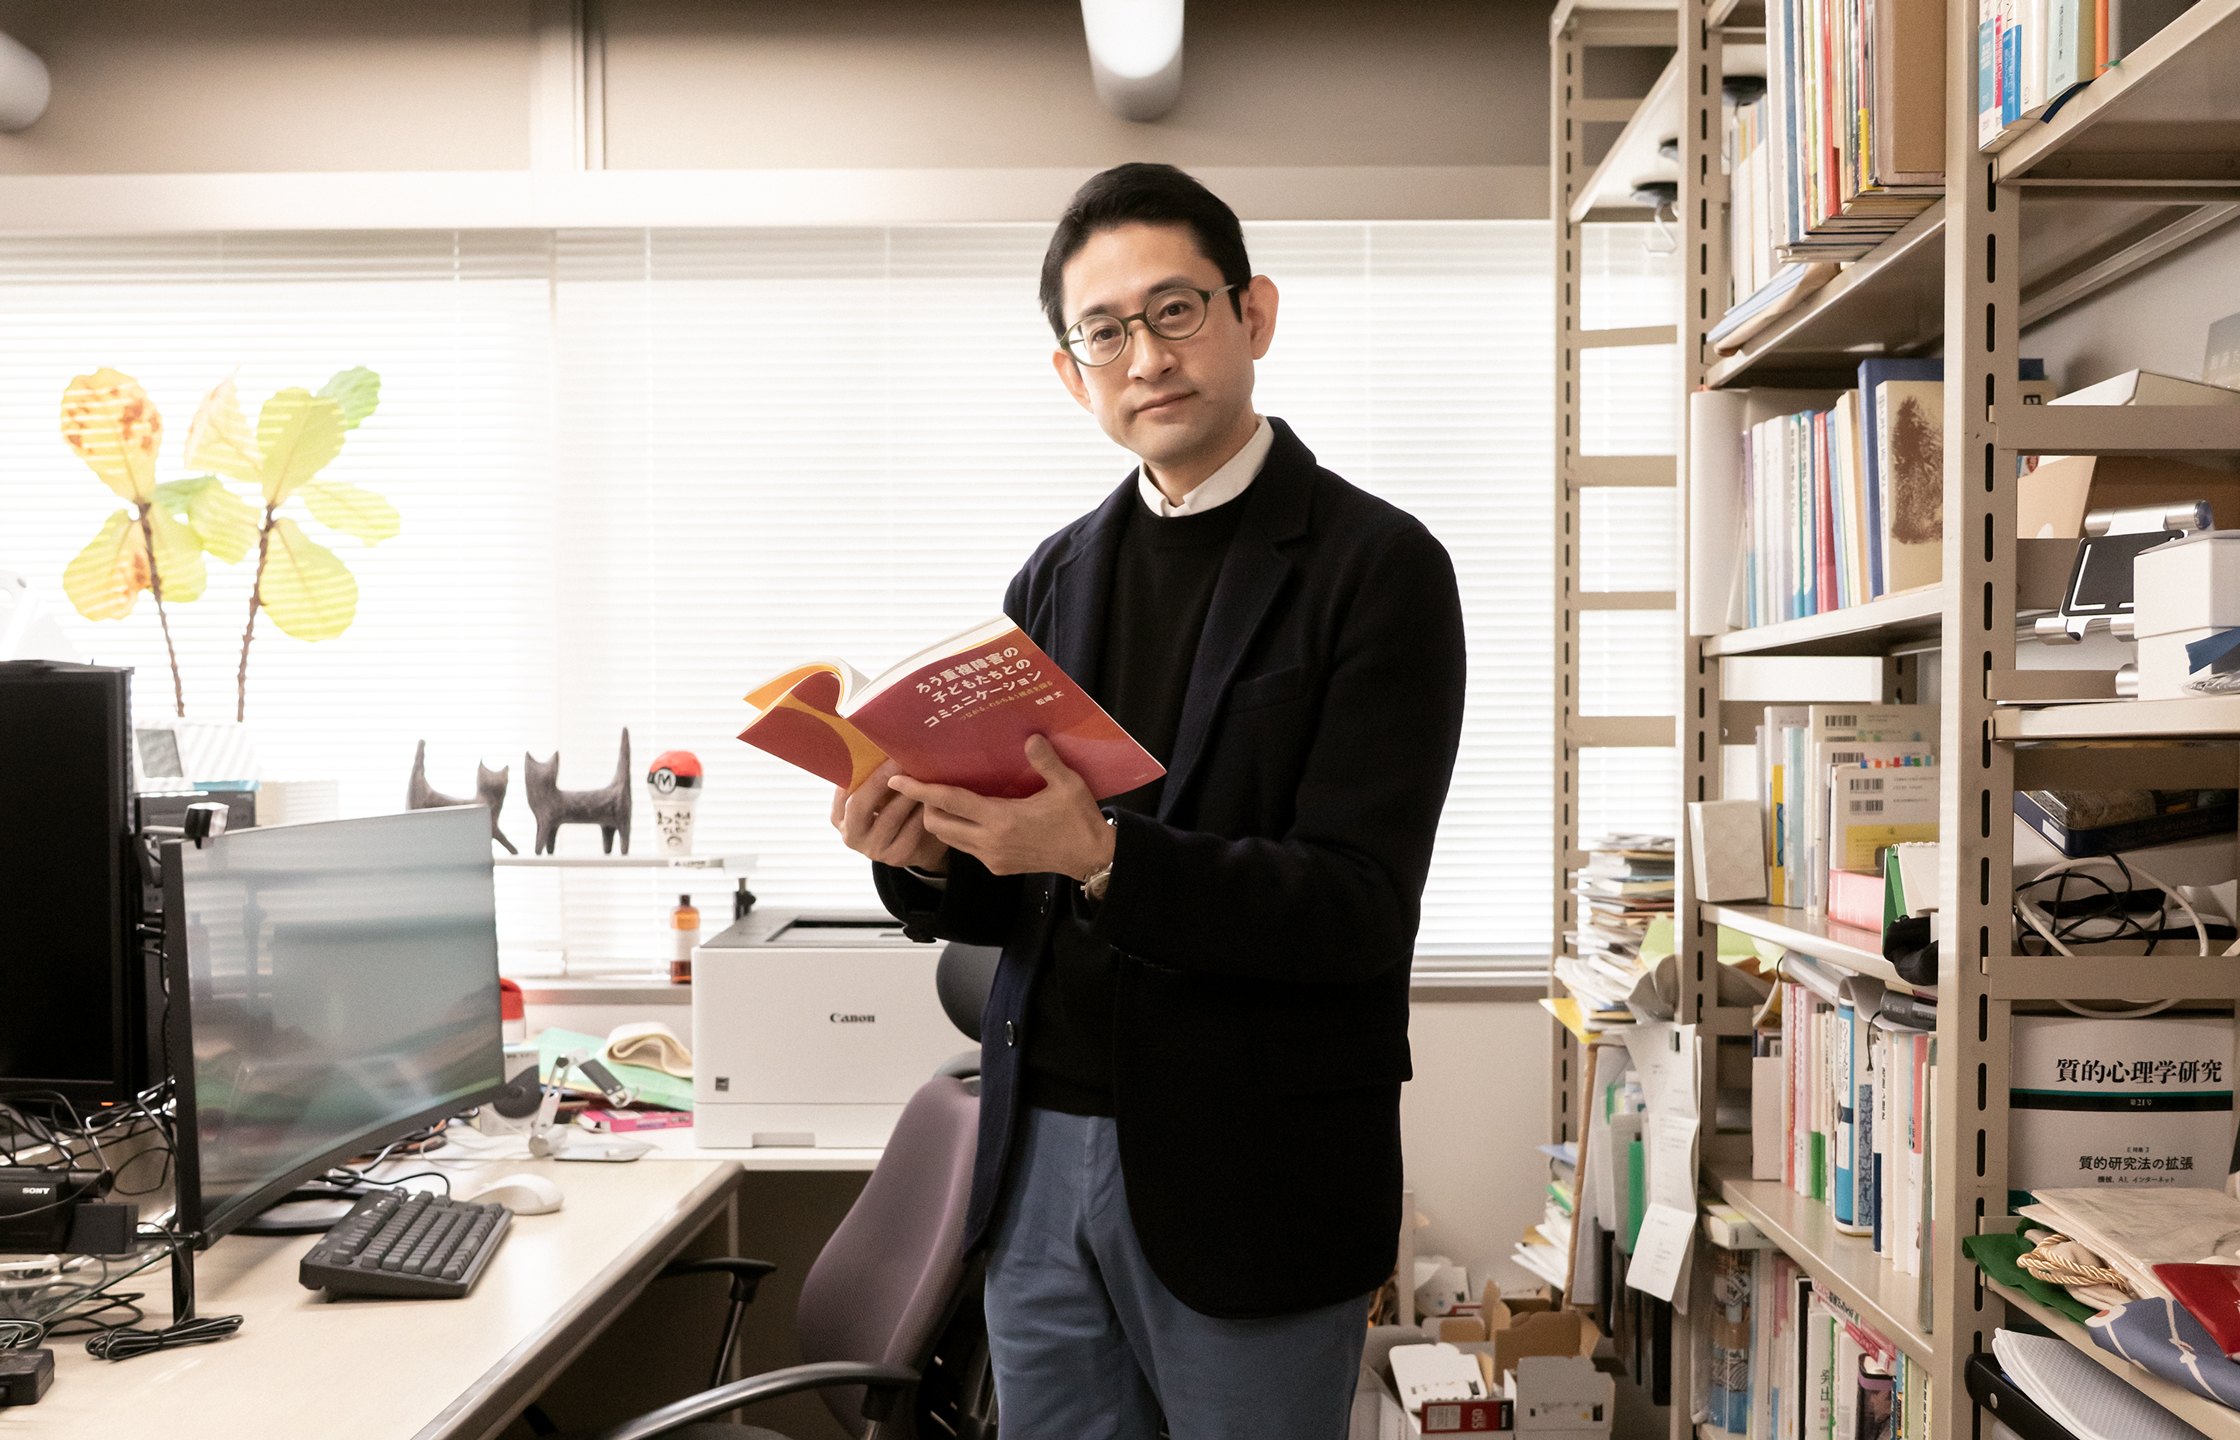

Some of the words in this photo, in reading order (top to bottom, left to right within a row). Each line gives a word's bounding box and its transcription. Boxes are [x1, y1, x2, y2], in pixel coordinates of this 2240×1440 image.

[916, 647, 1019, 694] ろう重複障害の
[932, 658, 1031, 704] 子どもたちとの
[924, 671, 1041, 728] コミュニケーション
[830, 1012, 875, 1023] Canon
[2056, 1059, 2222, 1084] 質的心理学研究
[2079, 1156, 2193, 1170] 質的研究法の拡張
